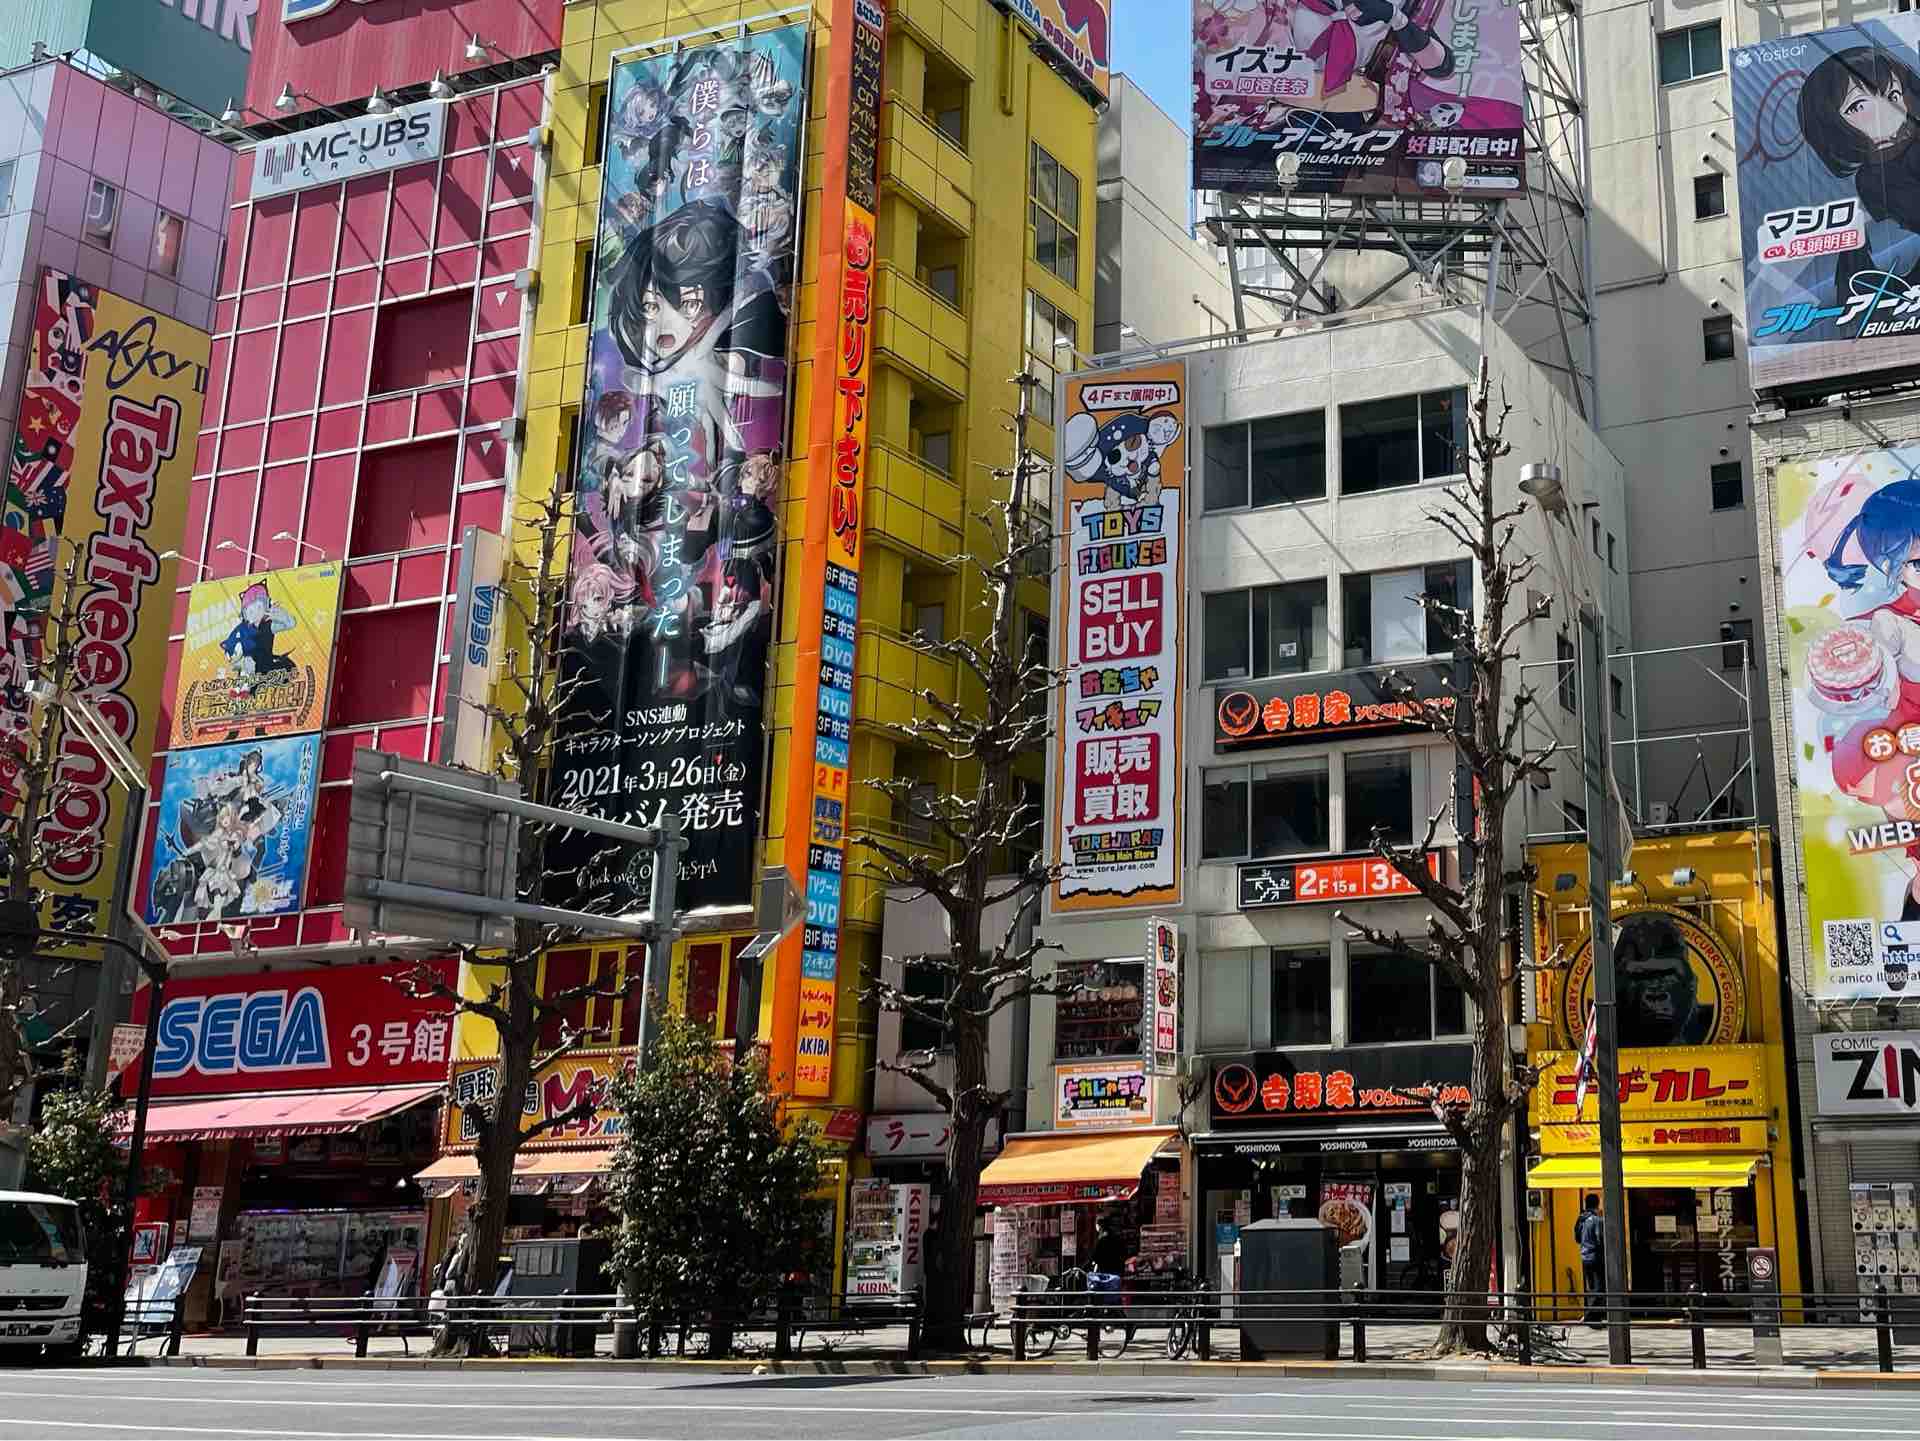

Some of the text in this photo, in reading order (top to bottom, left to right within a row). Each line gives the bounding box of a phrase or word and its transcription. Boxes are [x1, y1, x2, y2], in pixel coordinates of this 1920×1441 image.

[856, 23, 881, 53] DVD
[1216, 46, 1303, 74] イズナ
[1754, 44, 1808, 66] Yostar
[857, 86, 874, 107] CD
[1213, 79, 1230, 89] CV
[300, 111, 431, 168] MC-UBS
[686, 79, 720, 190] 僕らは
[1202, 125, 1405, 153] ブルーアーカイブ
[1406, 135, 1519, 157] 好評配信中!
[302, 142, 426, 178] GROUP
[1766, 200, 1856, 240] マシロ
[1790, 229, 1859, 259] 鬼頭明里
[1086, 385, 1173, 406] 4Fまで展開中!
[1081, 505, 1164, 541] TOYS
[77, 395, 182, 691] Tax-free
[1077, 537, 1167, 576] FIGURES
[1083, 578, 1159, 616] SELL
[468, 585, 499, 669] SEGA
[1115, 613, 1125, 624] &
[1085, 620, 1154, 659] BUY
[824, 644, 853, 668] DVD
[1080, 665, 1160, 699] おもちゃ
[624, 703, 688, 728] SNS連動
[819, 694, 850, 717] DVD
[1076, 699, 1163, 734] フィギュア
[1261, 689, 1351, 733] 吉野家
[564, 718, 746, 758] キャラクターソングプロジェクト
[1085, 736, 1151, 777] 販売
[561, 755, 747, 800] 2021年3月26日(金)
[1112, 772, 1121, 785] &
[1083, 782, 1150, 823] 買取
[1069, 828, 1164, 853] TOREJARAS
[1299, 868, 1329, 896] 2F
[807, 900, 838, 924] DVD
[1838, 972, 1873, 984] amico
[151, 986, 332, 1078] SEGA
[346, 1019, 450, 1068] 3号館
[800, 1009, 832, 1030] ムーラン
[798, 1036, 831, 1058] AKIBA
[1829, 1036, 1881, 1051] COMIC
[456, 1067, 498, 1104] 買取
[1261, 1070, 1355, 1111] 吉野家
[1234, 1137, 1458, 1154] YOSHINOYA YOSHINOYA YOSHINOYA
[906, 1188, 922, 1265] KIRIN
[857, 1282, 890, 1293] KIRIN
